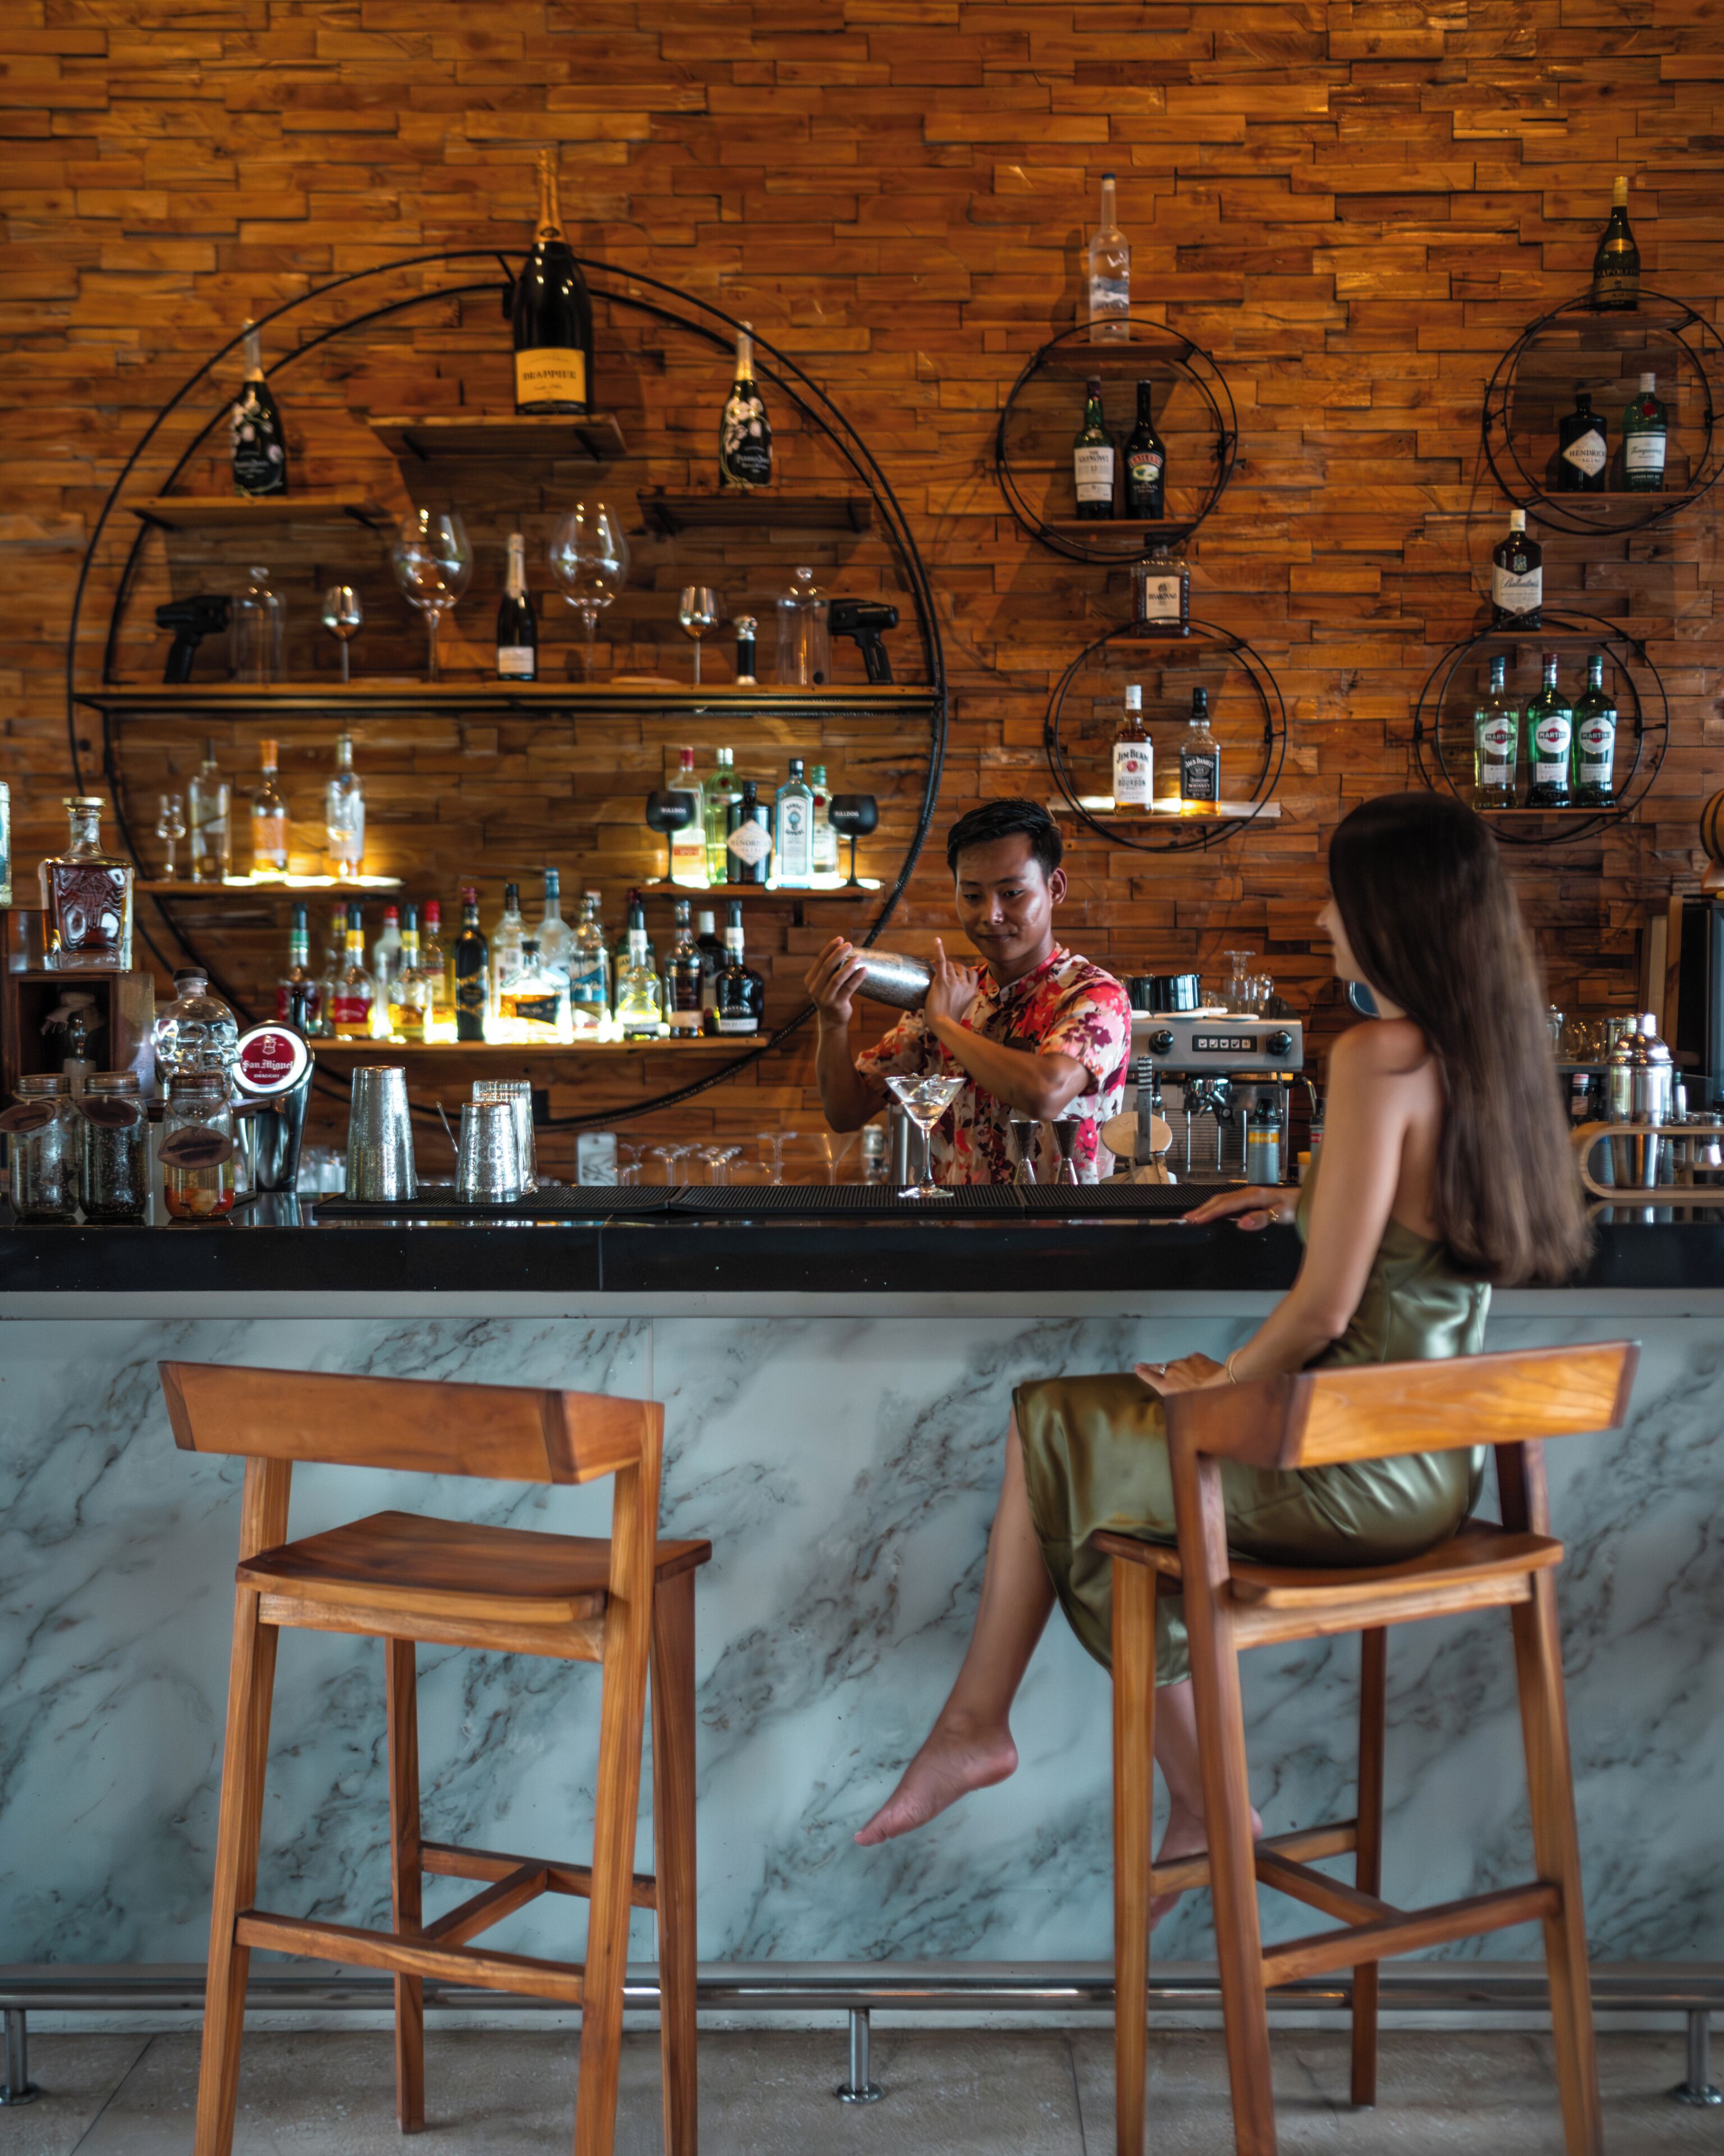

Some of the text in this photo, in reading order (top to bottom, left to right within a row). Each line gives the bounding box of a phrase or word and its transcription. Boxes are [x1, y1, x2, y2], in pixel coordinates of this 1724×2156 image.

[523, 370, 577, 380] DRAPPIER
[1117, 748, 1149, 764] JIM BEAM
[243, 1059, 293, 1072] San Miguel
